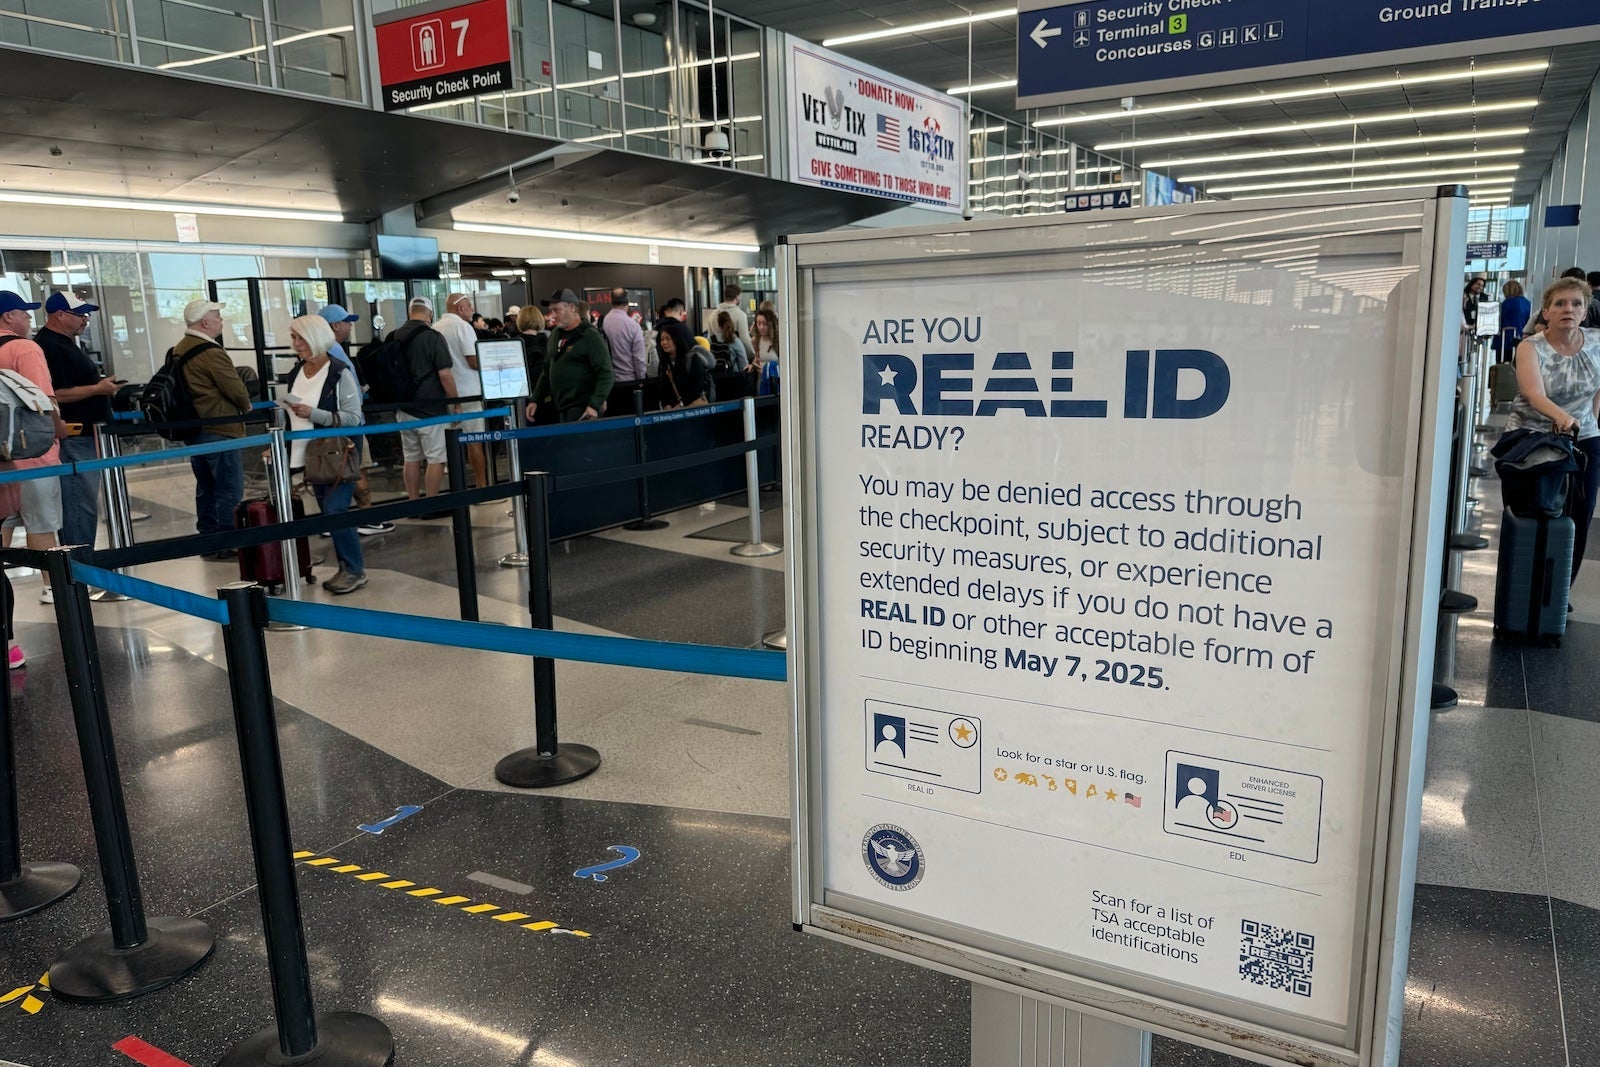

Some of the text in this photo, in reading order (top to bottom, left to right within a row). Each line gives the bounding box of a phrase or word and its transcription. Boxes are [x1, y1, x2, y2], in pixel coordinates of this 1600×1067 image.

[1097, 0, 1228, 23] Security Chec
[1379, 0, 1540, 22] Ground Tran
[451, 19, 469, 56] 7
[1096, 24, 1278, 62] Concourses G H K L
[1097, 18, 1182, 42] Terminal 3
[392, 71, 501, 103] Security Check Point
[858, 79, 915, 112] DONATE NOW
[803, 93, 866, 137] VET TIX
[811, 158, 951, 200] GIVE SOMETHING TO THOSE WHO GAVE
[1118, 191, 1129, 205] A
[587, 292, 612, 304] LAN
[862, 316, 981, 344] ARE YOU
[862, 349, 1231, 419] REAL ID
[861, 424, 965, 451] READY?
[859, 474, 1301, 523] You may be denied access through
[859, 506, 1322, 560] the checkpoint, subject to additional
[860, 540, 1272, 594] security measures, or experience
[860, 571, 1333, 639] extended delays if you do not have a
[861, 599, 1315, 674] REAL ID or other acceptable form of
[862, 629, 1169, 690] ID beginning May 7, 2025.
[997, 747, 1147, 784] Look for a star or U.S. flag.
[1249, 776, 1289, 788] ENHANCED
[907, 784, 934, 795] REAL ID
[1242, 782, 1296, 797] DRIVER LICENSE
[1230, 852, 1247, 862] EDL
[1092, 908, 1205, 947] TSA acceptable
[1093, 890, 1215, 930] Scan for a list of
[1092, 925, 1198, 963] identifications
